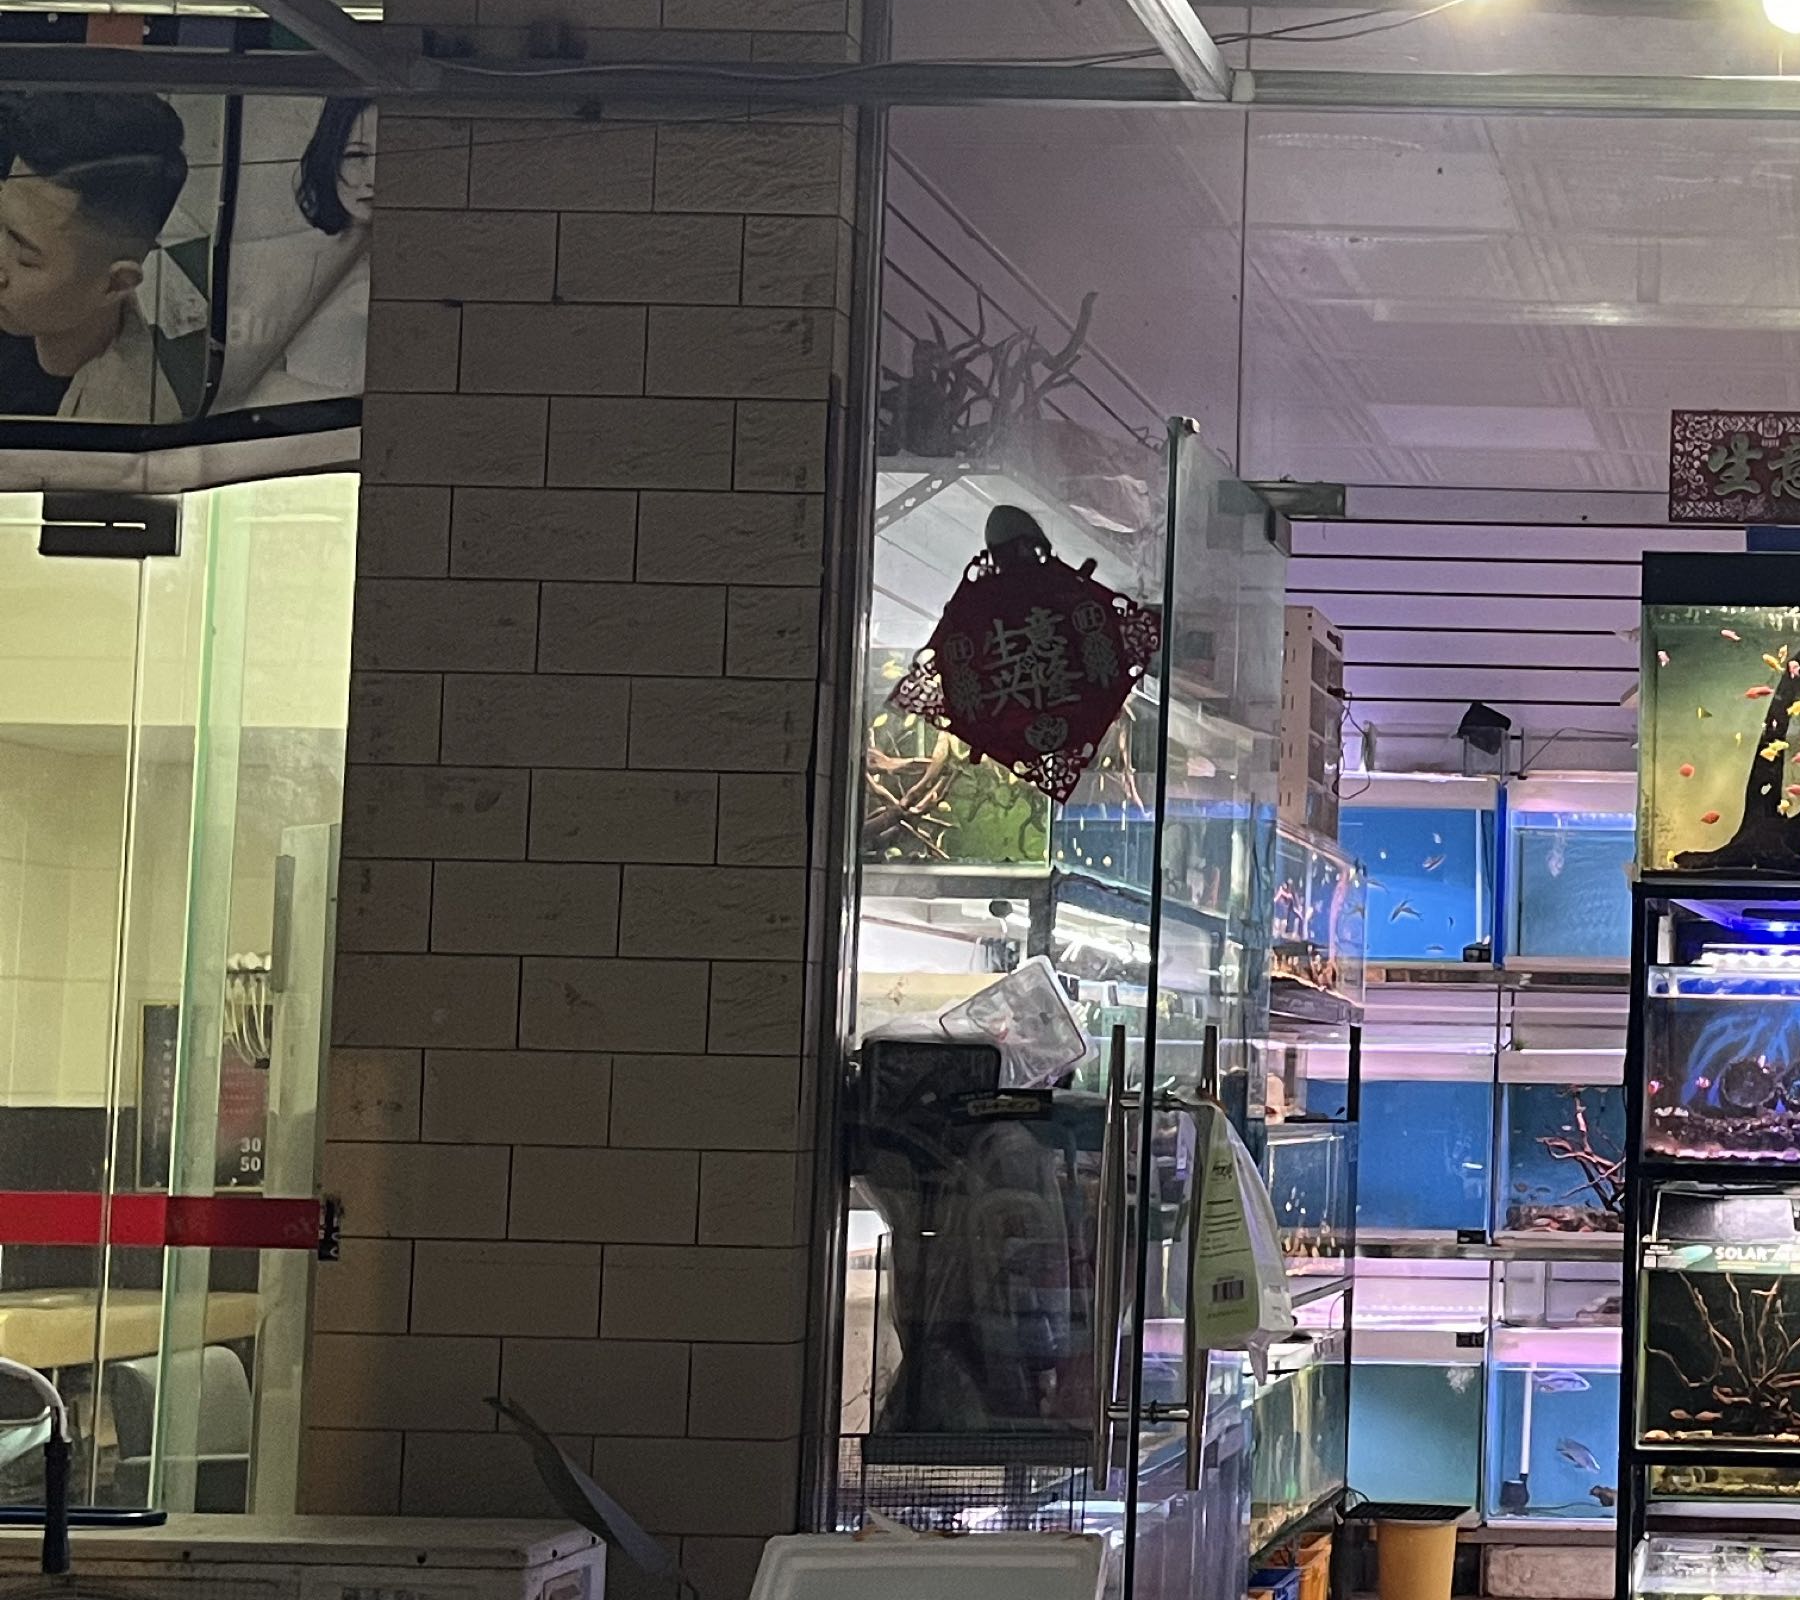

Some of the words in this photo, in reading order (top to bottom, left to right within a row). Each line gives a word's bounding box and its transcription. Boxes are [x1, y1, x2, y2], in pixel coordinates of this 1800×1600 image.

[240, 1137, 262, 1153] 30
[240, 1158, 262, 1172] 50
[1715, 1246, 1768, 1261] SOLAR
